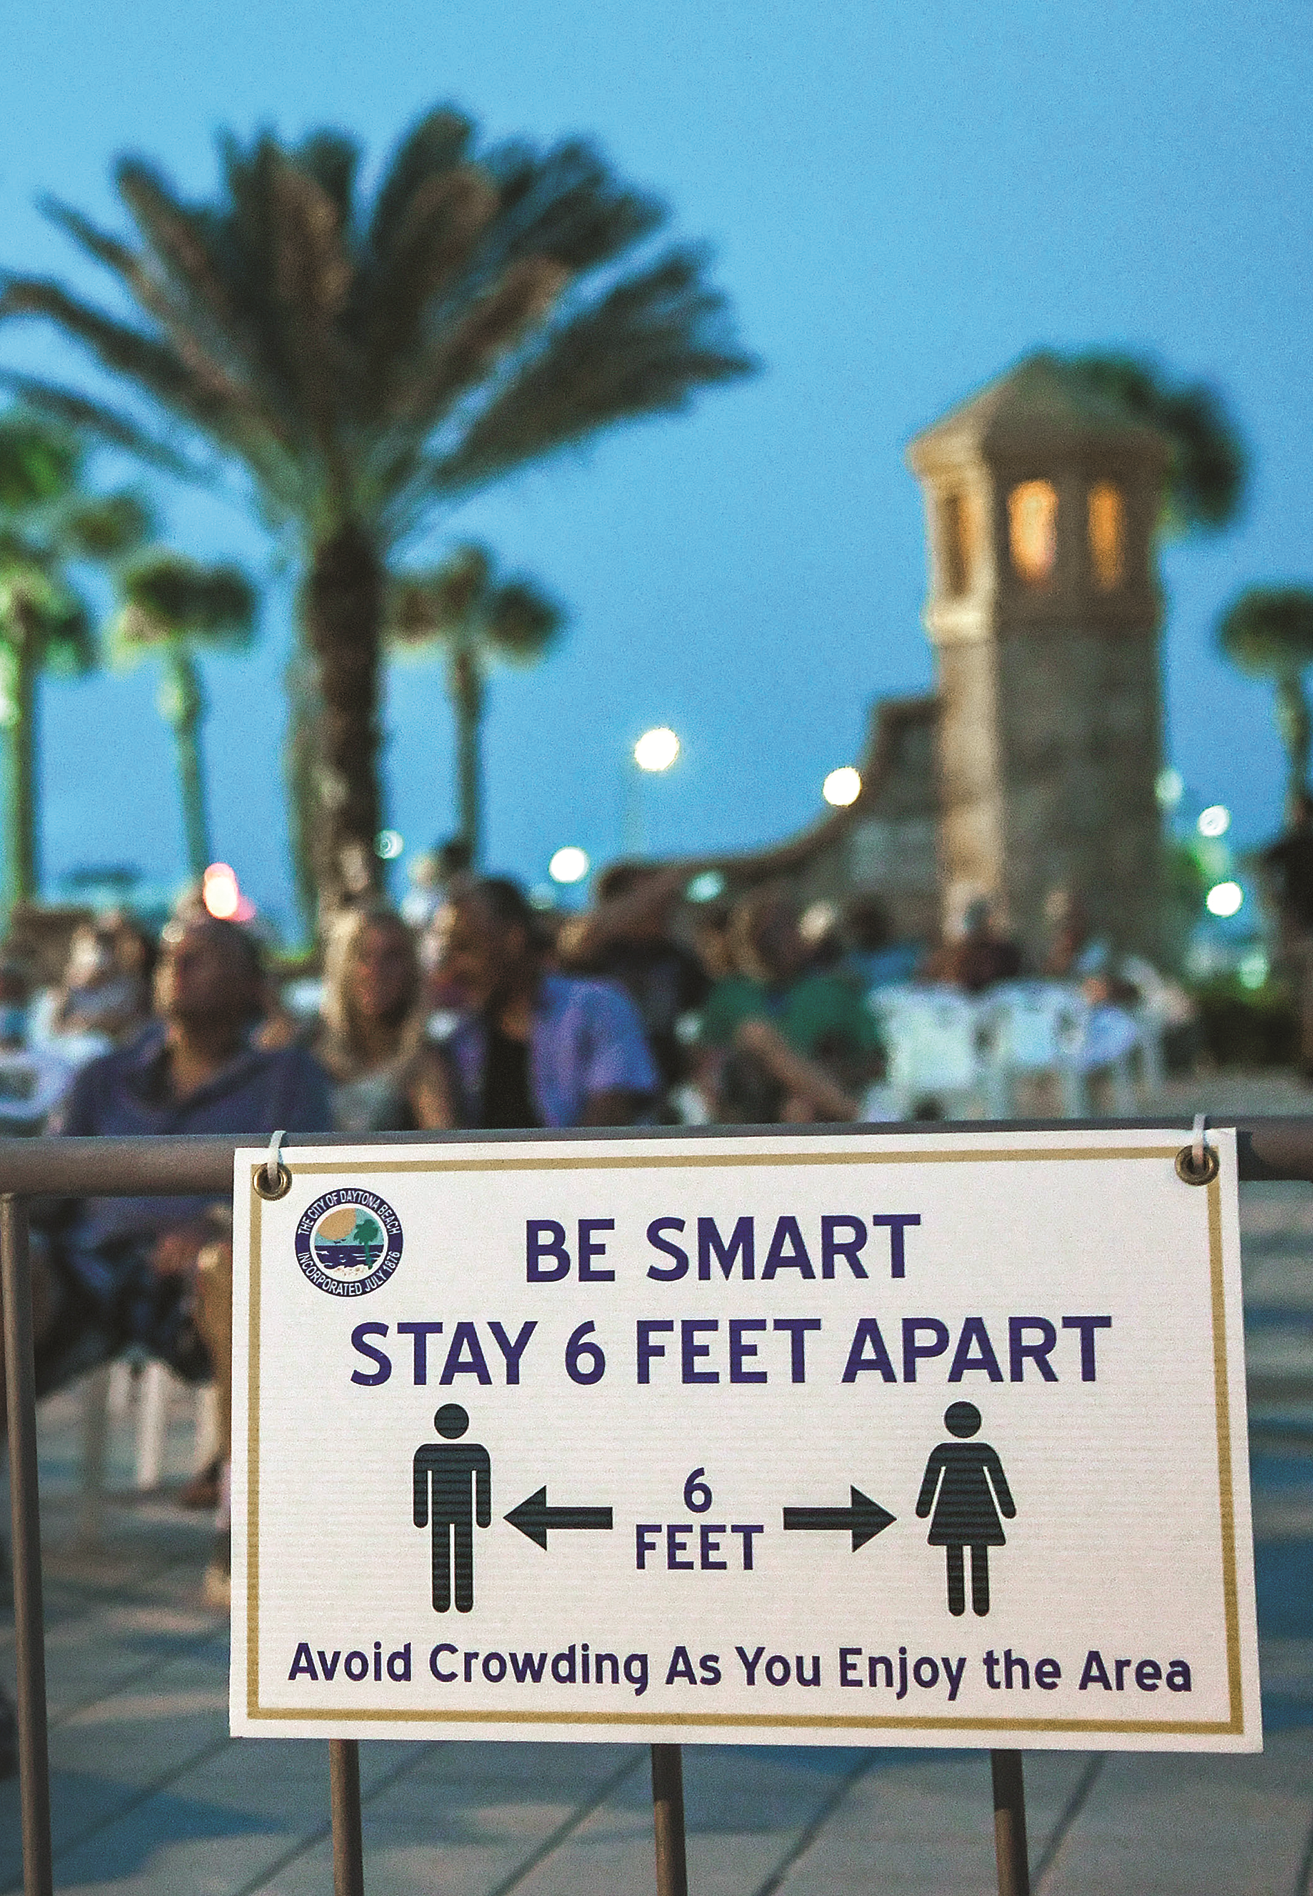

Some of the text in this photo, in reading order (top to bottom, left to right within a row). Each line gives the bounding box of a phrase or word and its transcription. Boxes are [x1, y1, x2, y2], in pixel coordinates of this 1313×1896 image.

[297, 1191, 400, 1235] THE CITY OF DAYTONA BEACH
[526, 1214, 921, 1282] BE SMART
[298, 1251, 400, 1295] INCORPORATED JULY 1876
[351, 1316, 1112, 1386] STAY 6 FEET APART
[684, 1467, 712, 1513] 6
[636, 1524, 764, 1570] FEET
[288, 1641, 1192, 1701] Avoid Crowding As You Enjoy the Area
